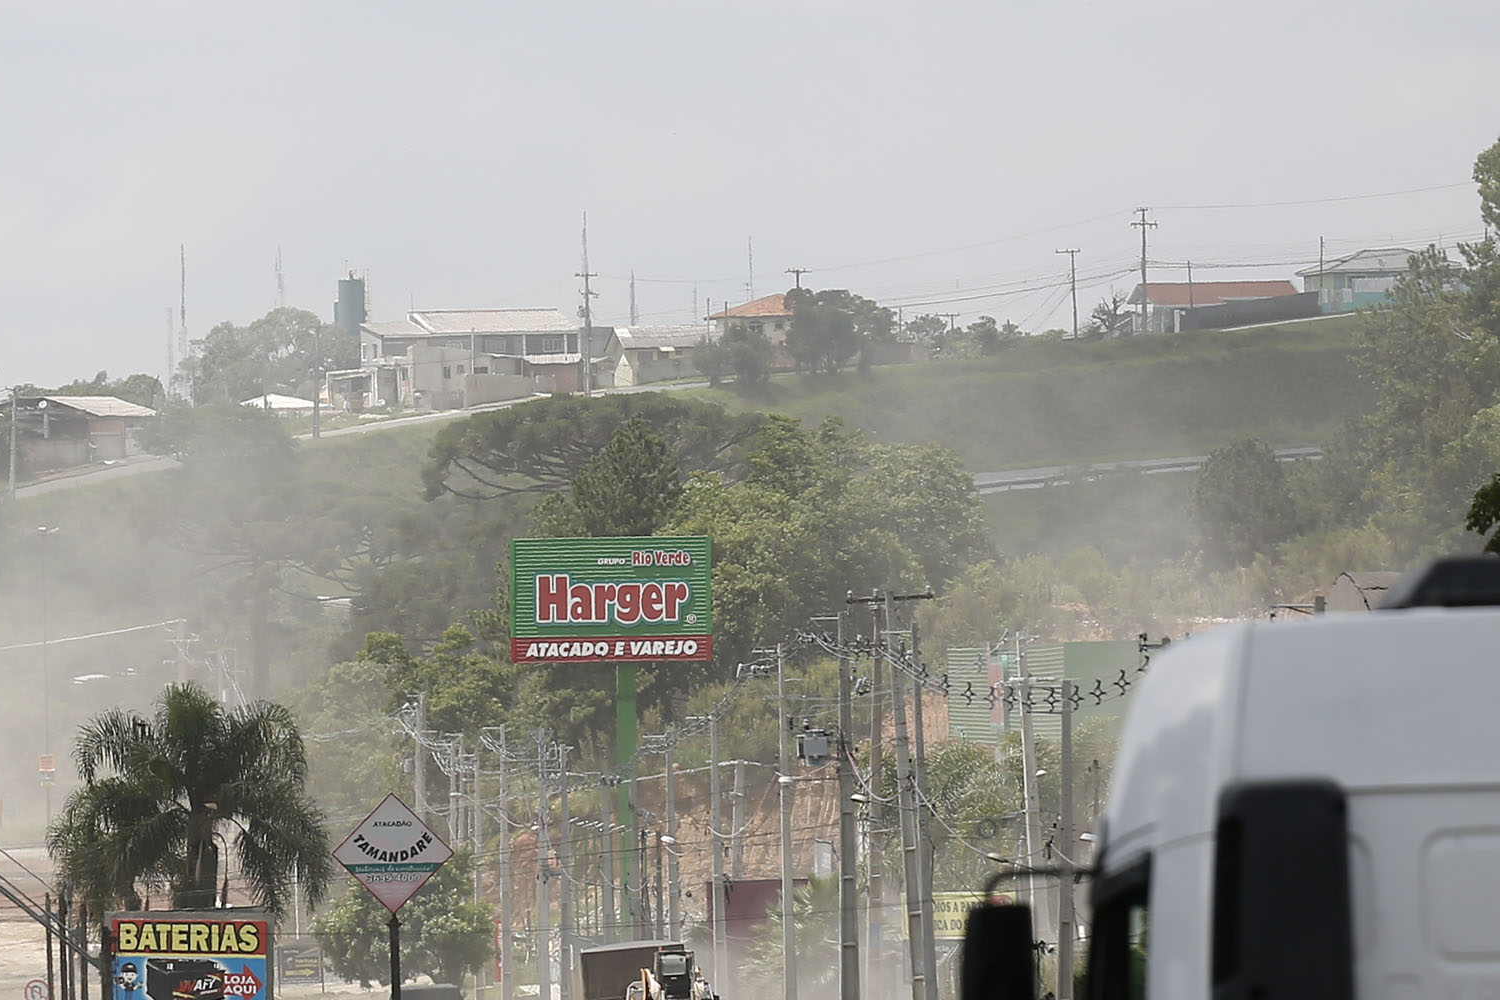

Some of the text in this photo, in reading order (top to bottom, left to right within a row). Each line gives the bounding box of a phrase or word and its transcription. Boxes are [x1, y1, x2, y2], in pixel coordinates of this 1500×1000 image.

[597, 551, 691, 566] GRUPO Rio Verde
[536, 574, 689, 625] Harger
[525, 640, 698, 658] ATACADO E VAREJO
[372, 820, 412, 828] ATACADÃO
[353, 831, 433, 862] TAMANDARÉ
[119, 922, 259, 952] BATERIAS
[224, 976, 255, 984] LOJA
[223, 985, 257, 995] AQUI
